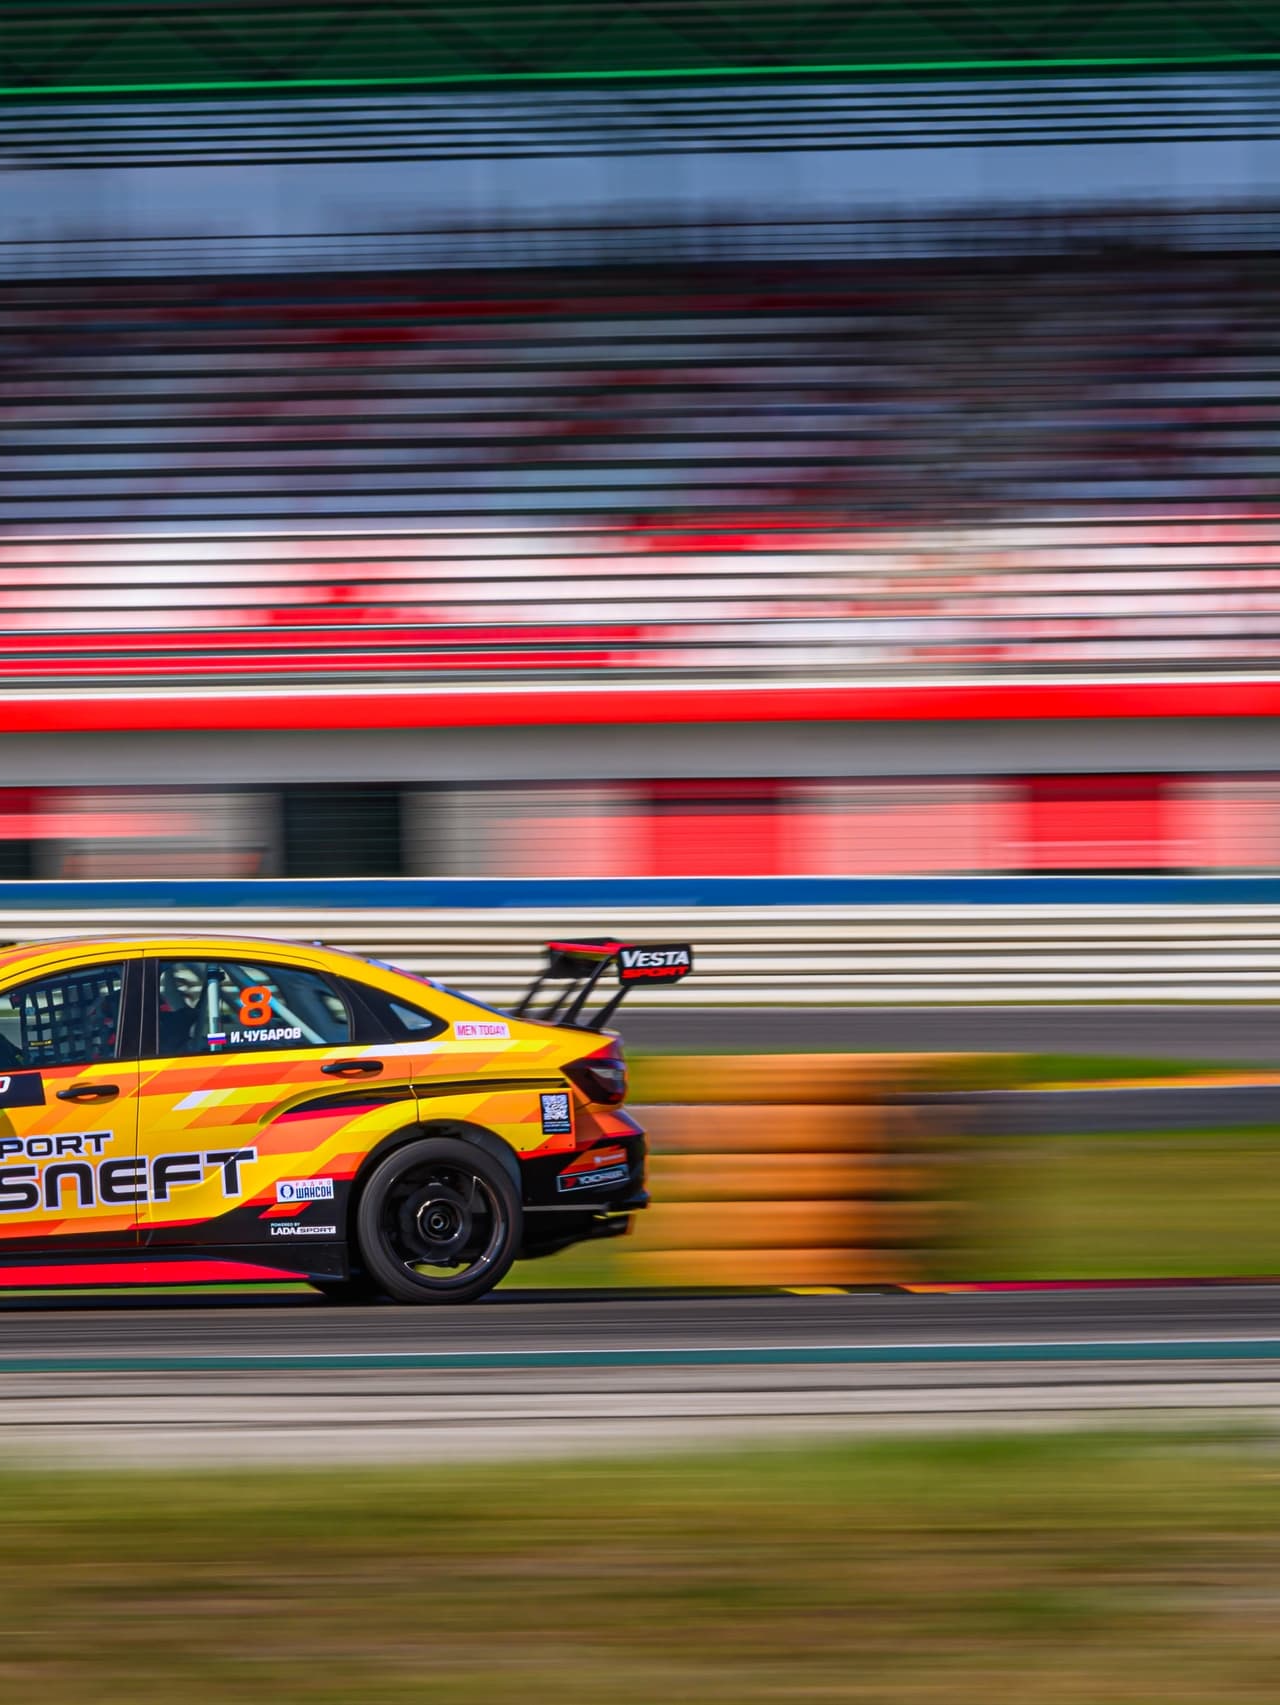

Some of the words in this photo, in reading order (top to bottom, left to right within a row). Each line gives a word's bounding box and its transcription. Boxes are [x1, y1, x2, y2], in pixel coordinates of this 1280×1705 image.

[622, 950, 689, 967] VESTA
[621, 966, 689, 978] SPORT
[239, 985, 272, 1027] 8
[230, 1027, 301, 1043] И.ЧУБАРОВ
[457, 1024, 476, 1036] MEN
[479, 1024, 506, 1036] TODAY
[296, 1186, 332, 1199] ШАНСОН
[271, 1227, 296, 1235] LADA
